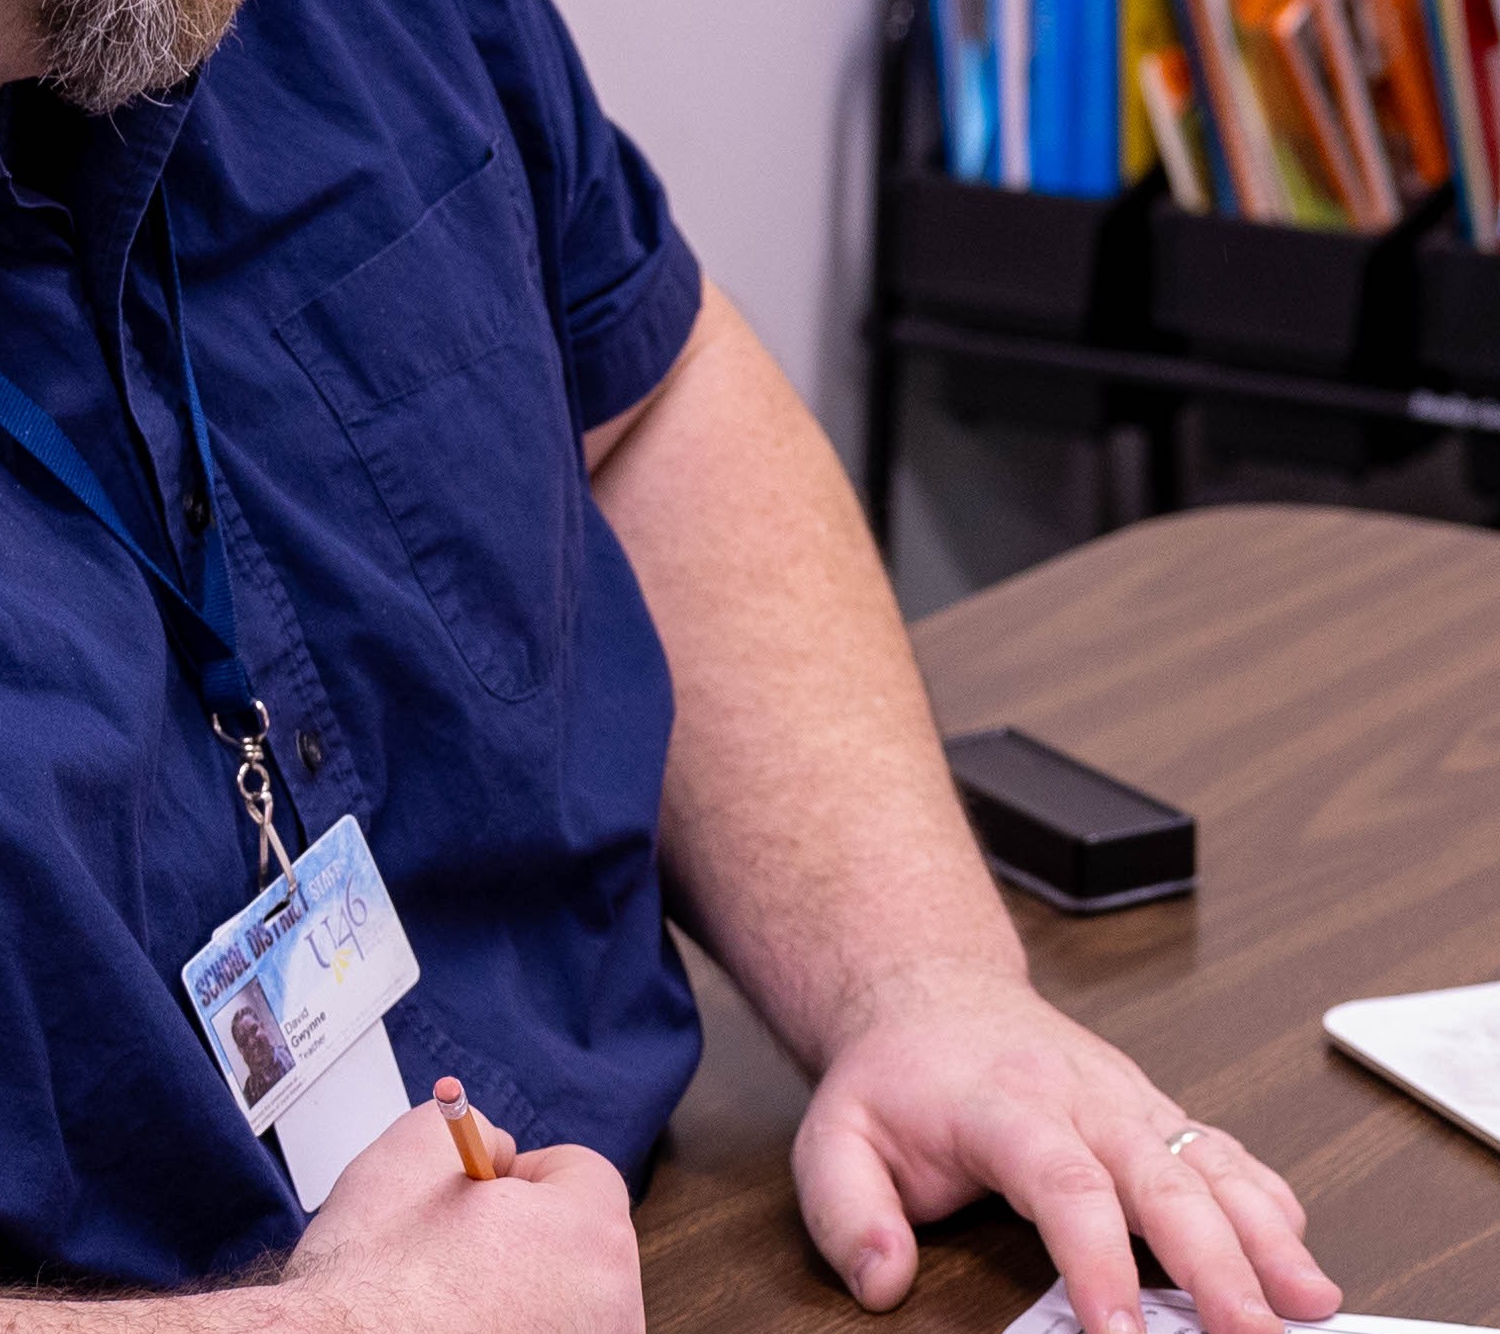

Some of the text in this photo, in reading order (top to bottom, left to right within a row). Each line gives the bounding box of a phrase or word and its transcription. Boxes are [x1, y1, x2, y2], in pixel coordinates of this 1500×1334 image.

[196, 943, 250, 1006] SCHOOL
[311, 860, 345, 900] STAFF
[284, 1007, 309, 1035] David
[291, 1011, 327, 1048] Gwynne
[299, 1033, 327, 1060] Teacher
